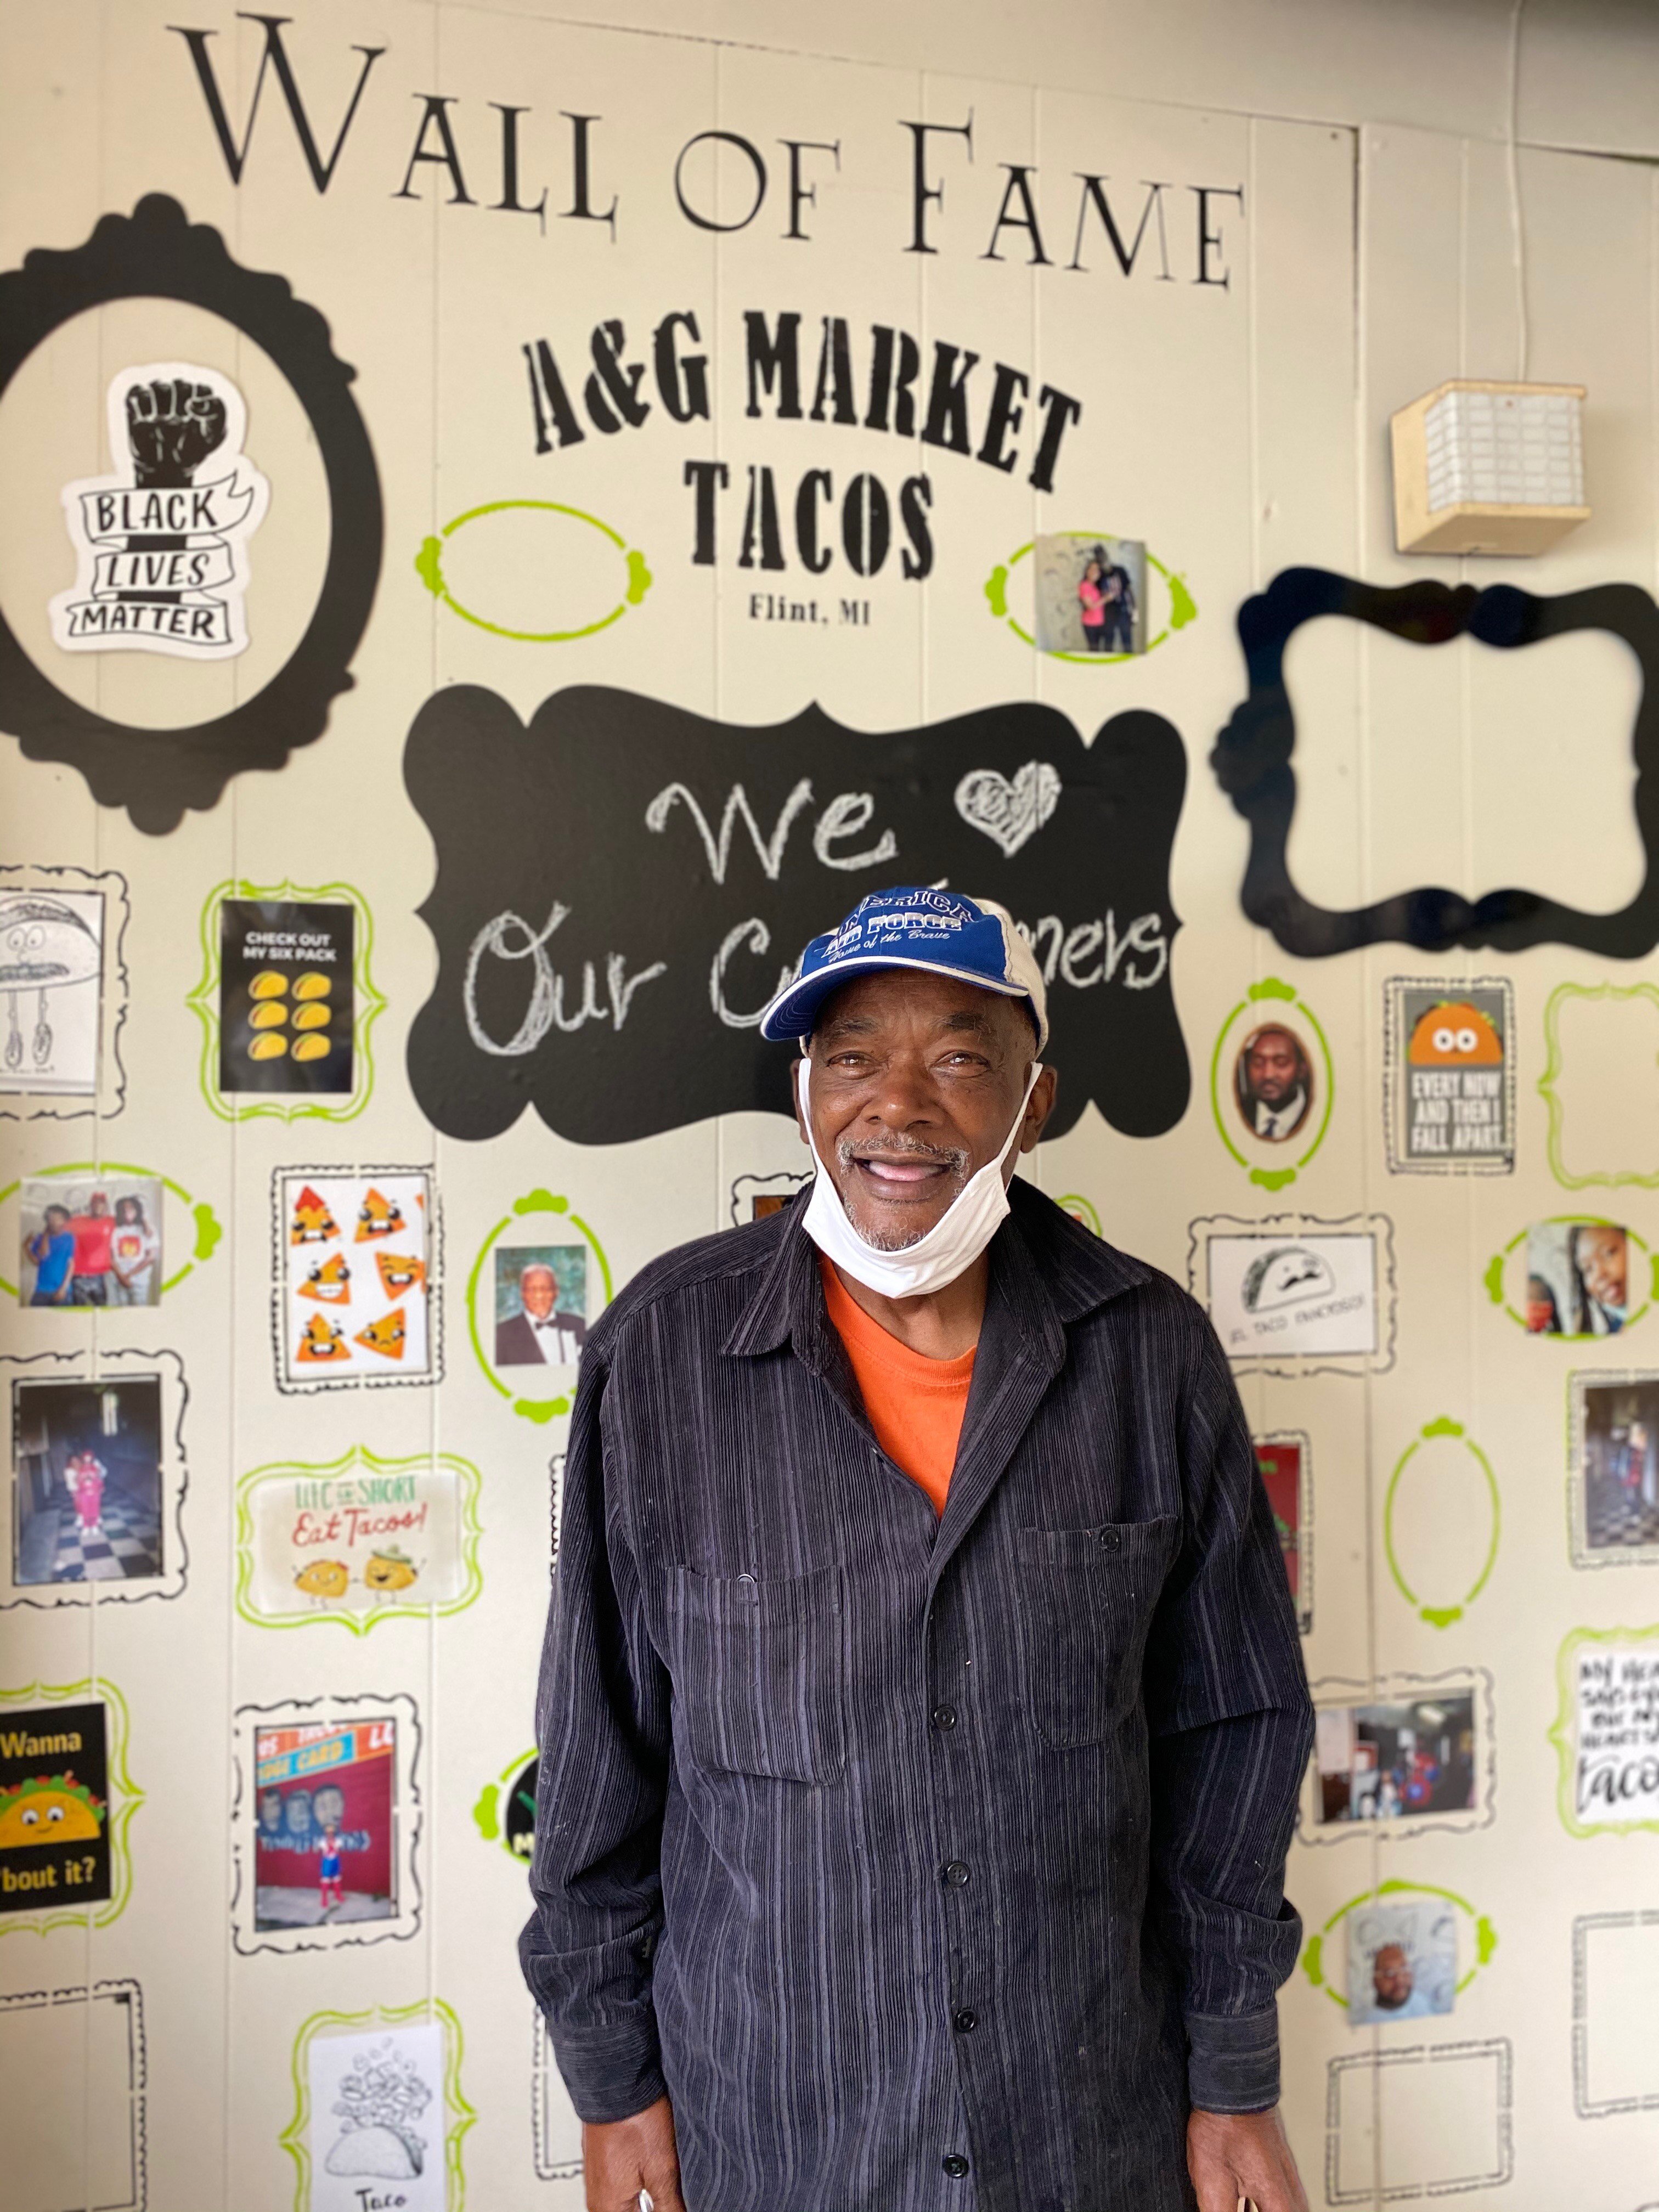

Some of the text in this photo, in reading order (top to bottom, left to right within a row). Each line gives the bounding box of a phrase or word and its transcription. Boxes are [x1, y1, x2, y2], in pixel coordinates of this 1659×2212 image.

[165, 11, 1244, 292] WALL OF FAME
[522, 310, 1081, 494] A&G MARKET
[96, 487, 218, 532] BLACK
[684, 460, 935, 582] TACOS
[106, 553, 211, 587] LIVES
[81, 603, 217, 639] MATTER
[749, 592, 871, 629] Flint, MI
[646, 777, 900, 884] We
[867, 912, 962, 934] FORCE
[242, 946, 337, 962] MY SIX PACK
[245, 931, 332, 947] CHECK OUT
[863, 934, 878, 949] of
[879, 930, 903, 944] the
[908, 929, 951, 940] Brave
[462, 900, 668, 1056] Our
[1412, 1071, 1502, 1098] EVERY NOW
[1415, 1098, 1449, 1124] AND
[1452, 1097, 1491, 1124] THEN
[1411, 1125, 1449, 1152] FALL
[358, 1475, 417, 1506] SHORT
[292, 1502, 427, 1548] Eat Tacos!
[0, 1731, 82, 1759] Wanna
[65, 1857, 97, 1885] it?
[354, 2187, 408, 2212] Taco
